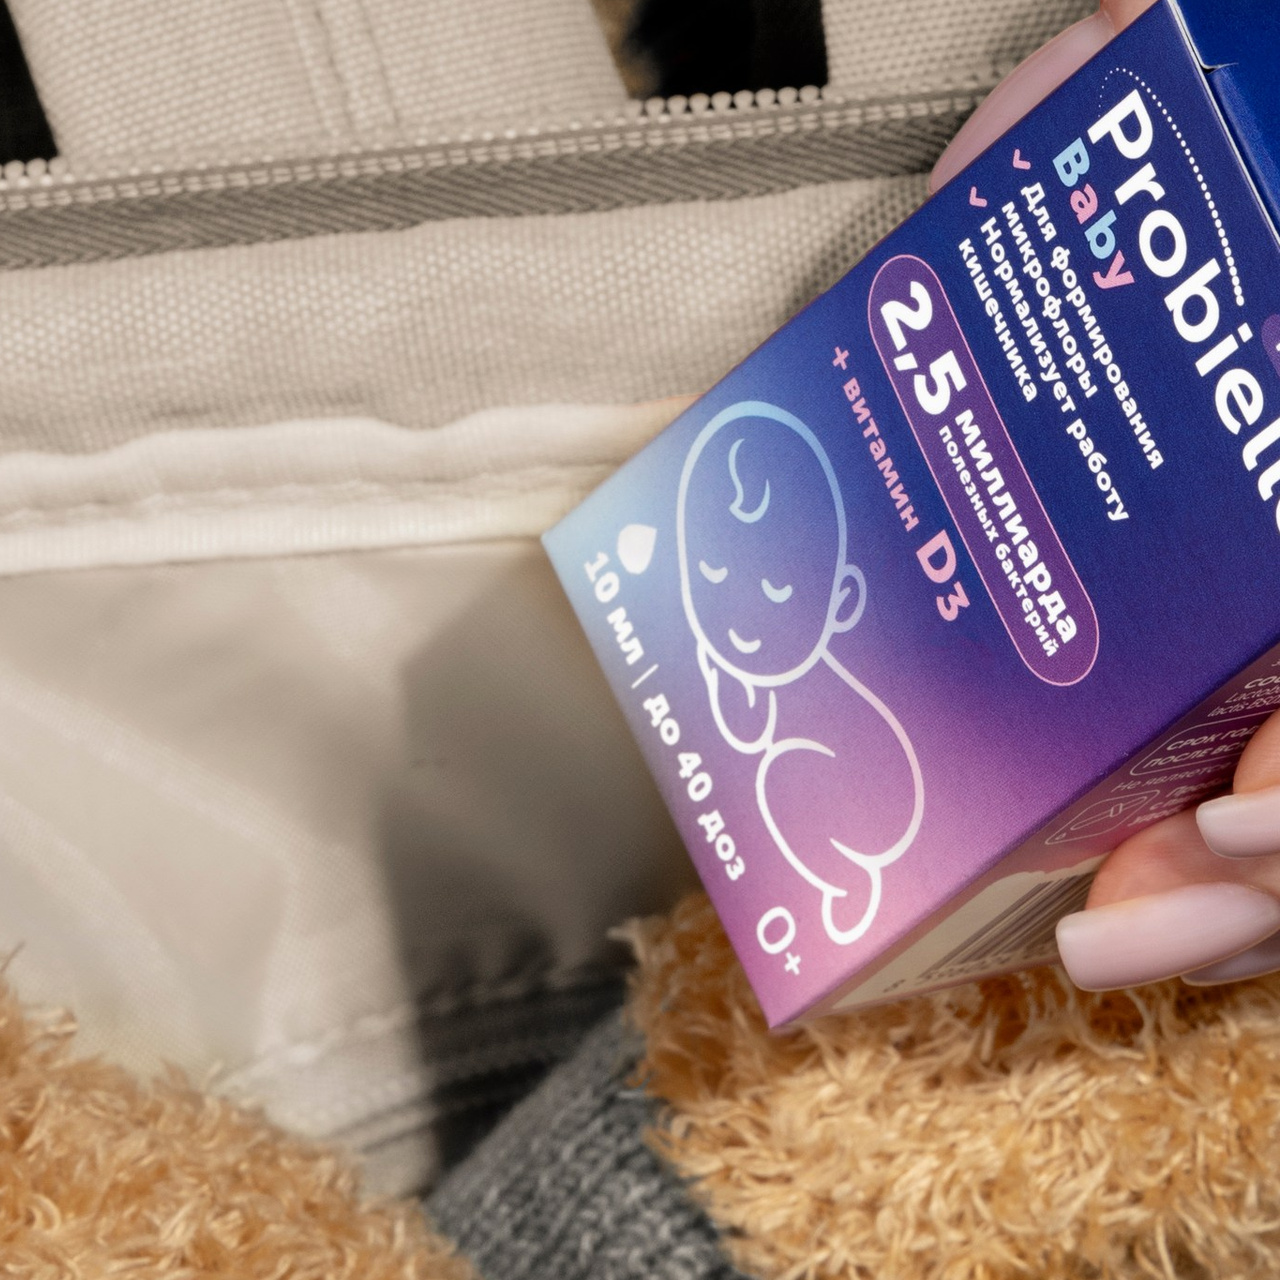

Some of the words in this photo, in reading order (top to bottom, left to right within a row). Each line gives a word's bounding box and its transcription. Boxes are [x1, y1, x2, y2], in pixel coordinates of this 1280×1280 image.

[1002, 202, 1097, 398] микрофлоры
[1053, 137, 1134, 288] Baby
[959, 238, 1037, 402] кишечника
[981, 217, 1076, 412] Нормализует
[1066, 419, 1129, 520] работу
[1021, 182, 1056, 242] Для
[1051, 246, 1163, 469] формирования
[843, 378, 919, 531] витамин
[916, 530, 970, 621] D3
[881, 281, 966, 415] 2,5
[955, 410, 1076, 643] миллиарда
[939, 426, 999, 542] полезных
[996, 544, 1059, 656] бактерий
[584, 552, 619, 602] 10
[607, 607, 643, 664] мл
[643, 694, 680, 745] до
[678, 753, 712, 801] 40
[698, 810, 745, 880] доз
[1110, 780, 1141, 793] Не
[1143, 747, 1212, 769] ПОСЛЕ
[1166, 732, 1222, 751] СРОК
